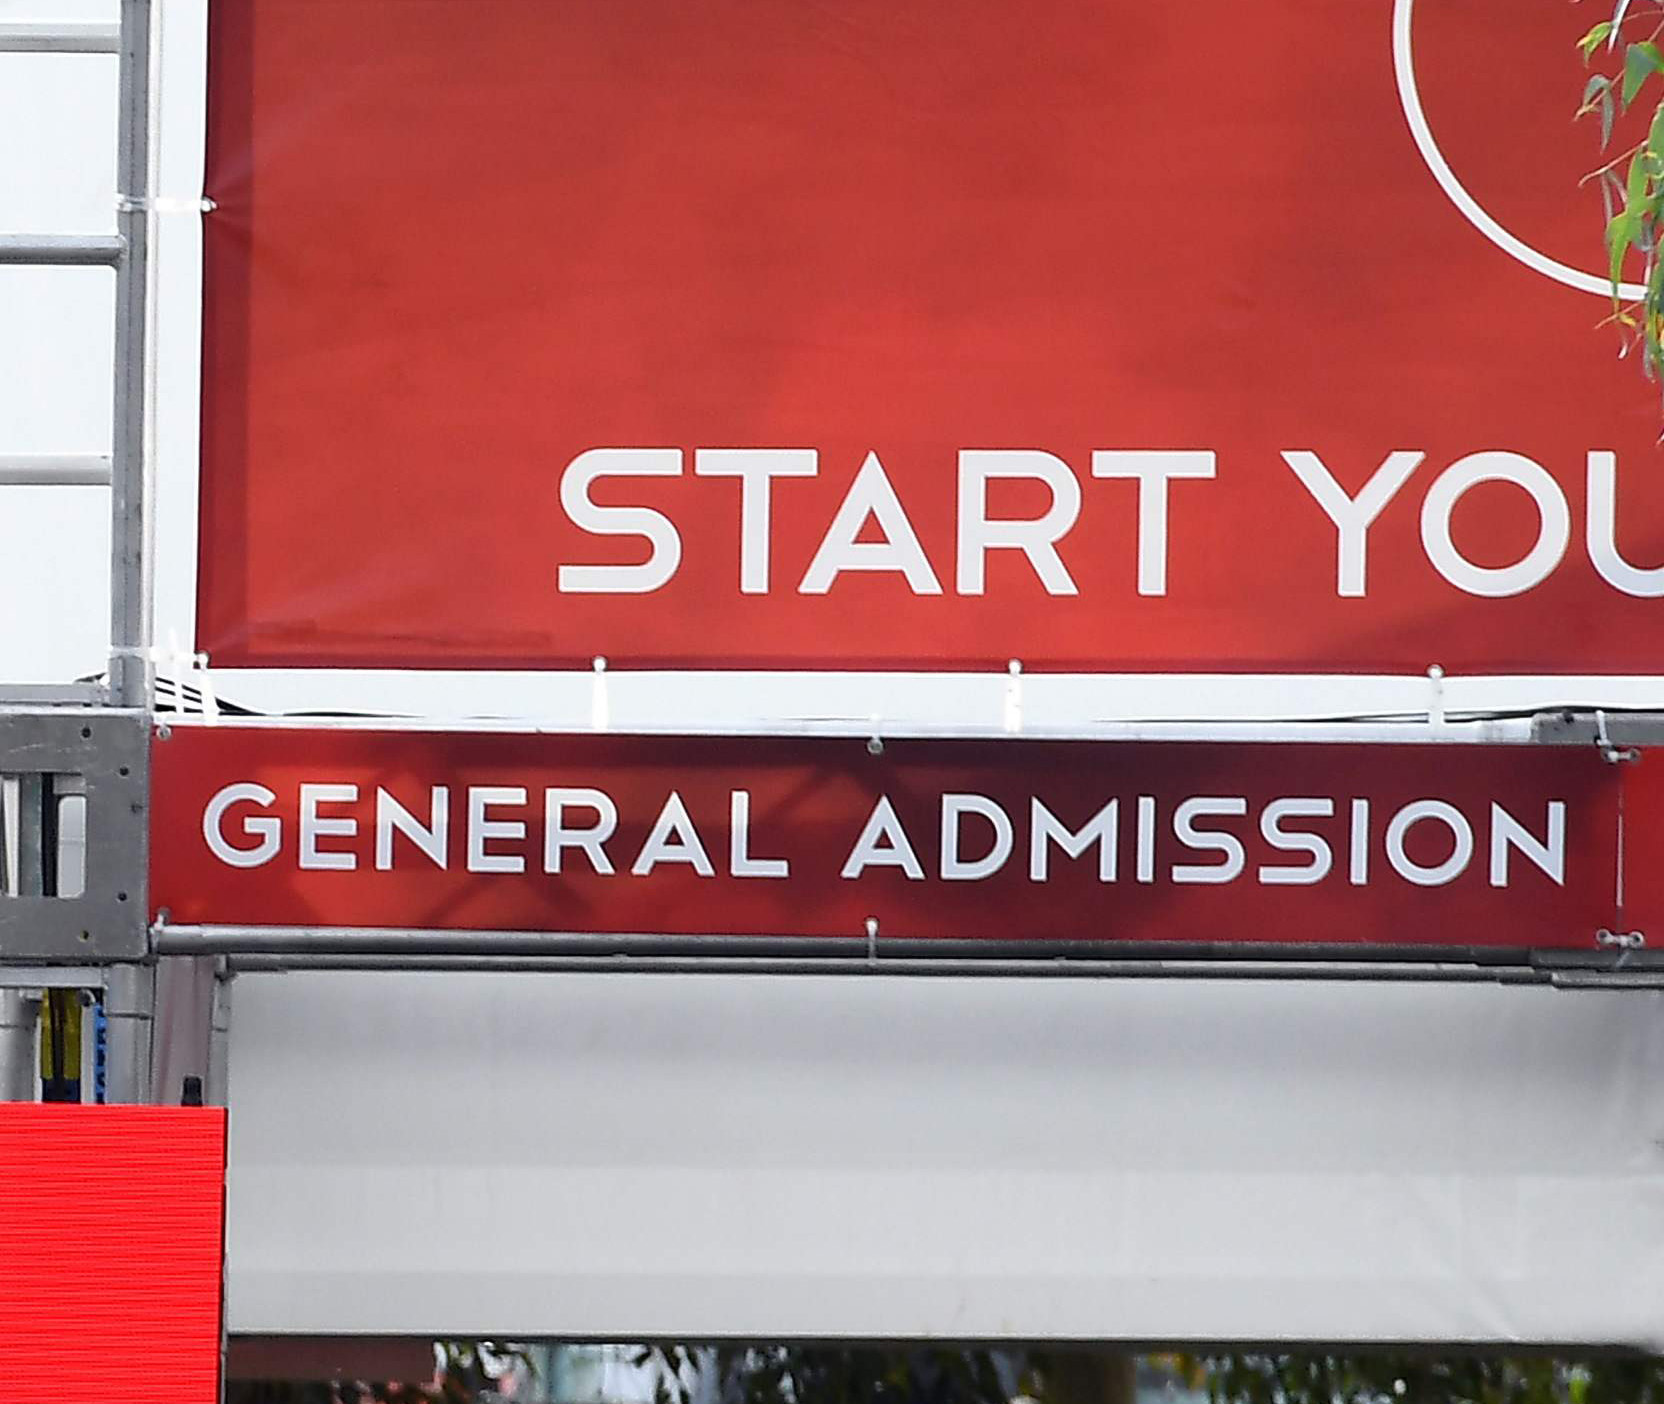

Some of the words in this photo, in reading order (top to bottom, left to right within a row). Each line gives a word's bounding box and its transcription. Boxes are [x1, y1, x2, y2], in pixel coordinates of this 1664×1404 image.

[557, 447, 1218, 597] START
[1280, 450, 1664, 598] YOU
[202, 782, 790, 878] GENERAL
[841, 792, 1566, 888] ADMISSION
